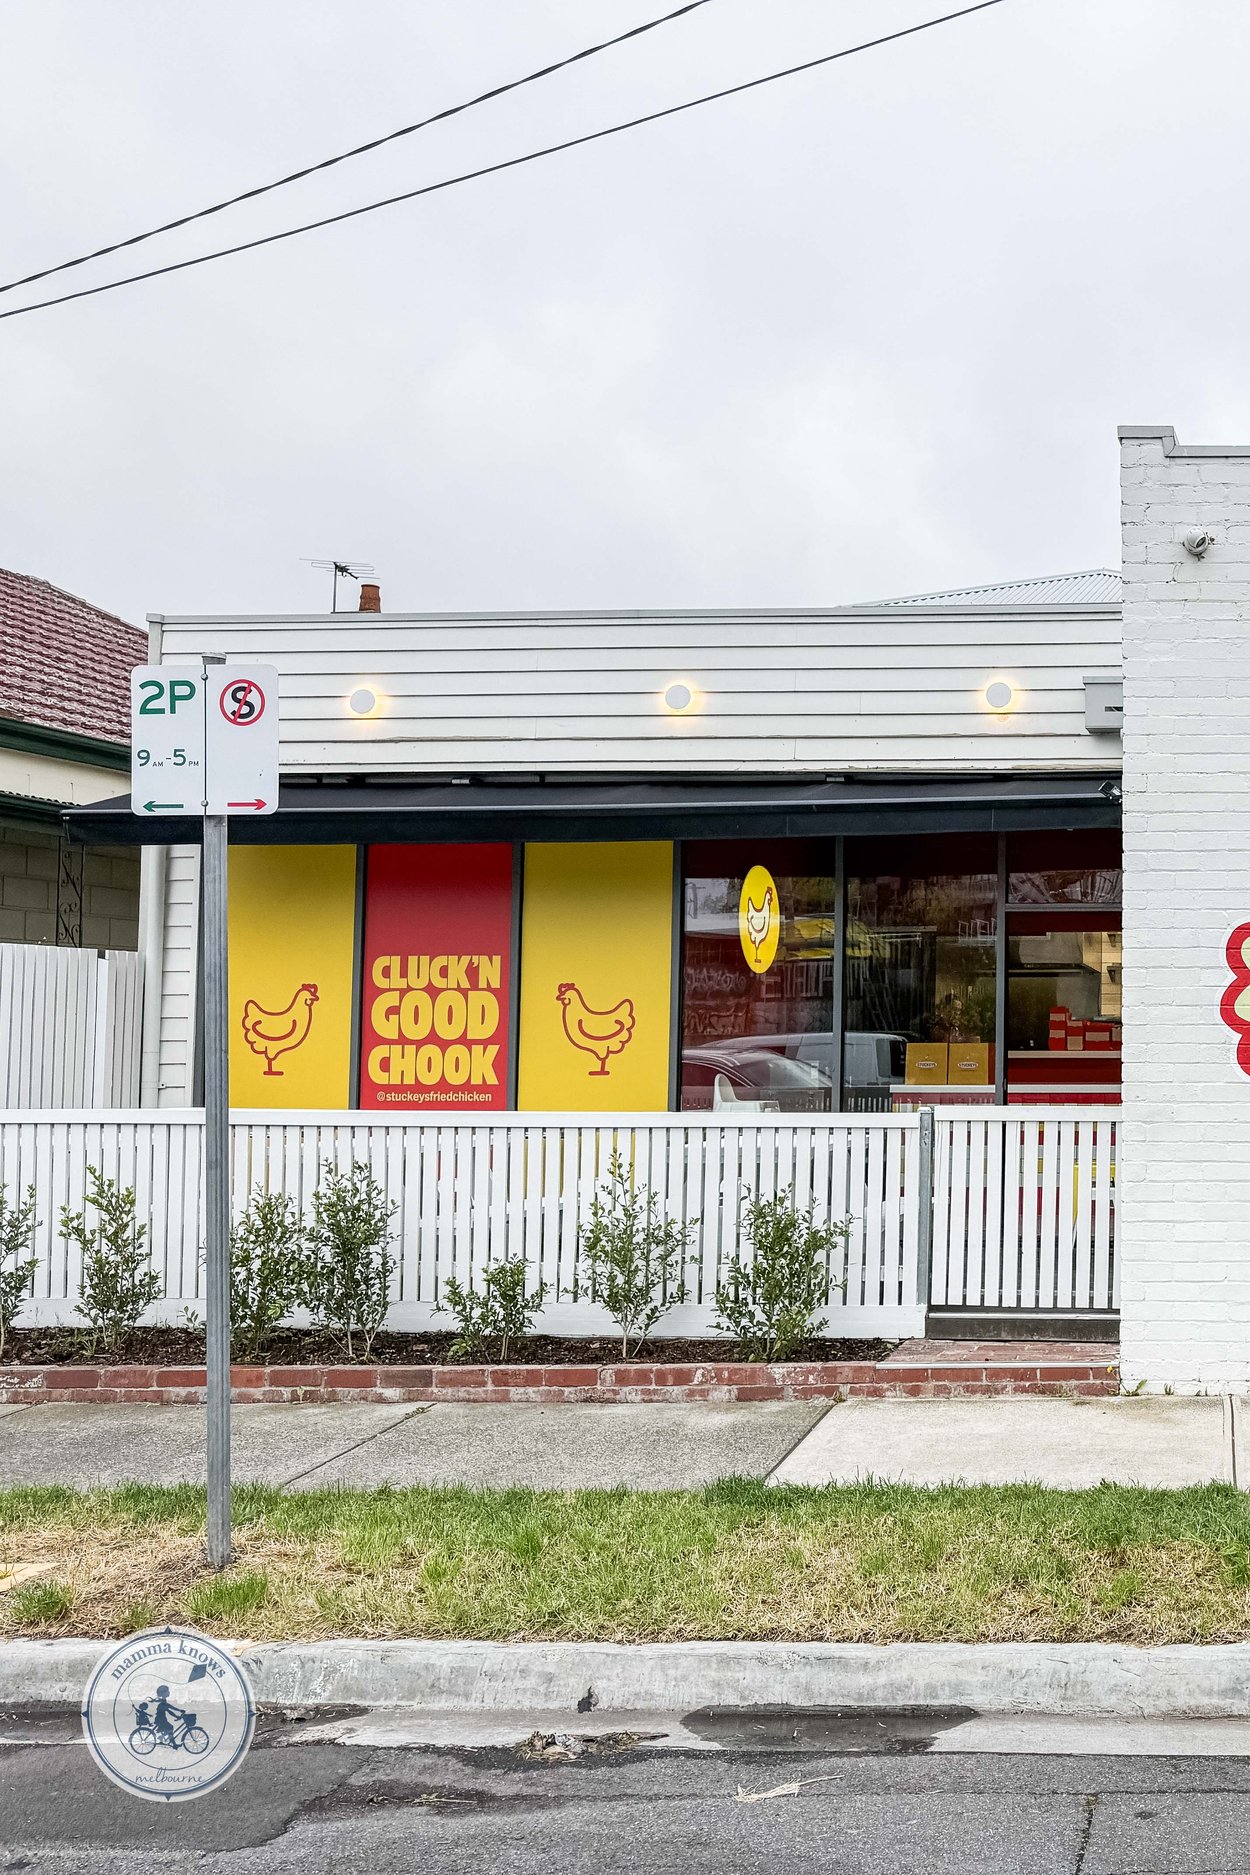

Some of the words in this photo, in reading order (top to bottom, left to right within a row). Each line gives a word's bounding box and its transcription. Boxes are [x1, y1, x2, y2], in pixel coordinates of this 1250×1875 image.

[138, 679, 197, 715] 2P
[371, 955, 502, 989] CLUCK'N
[370, 989, 500, 1041] GOOD
[367, 1043, 501, 1086] CHOOK
[376, 1090, 493, 1104] @stuckeysfriedchicken
